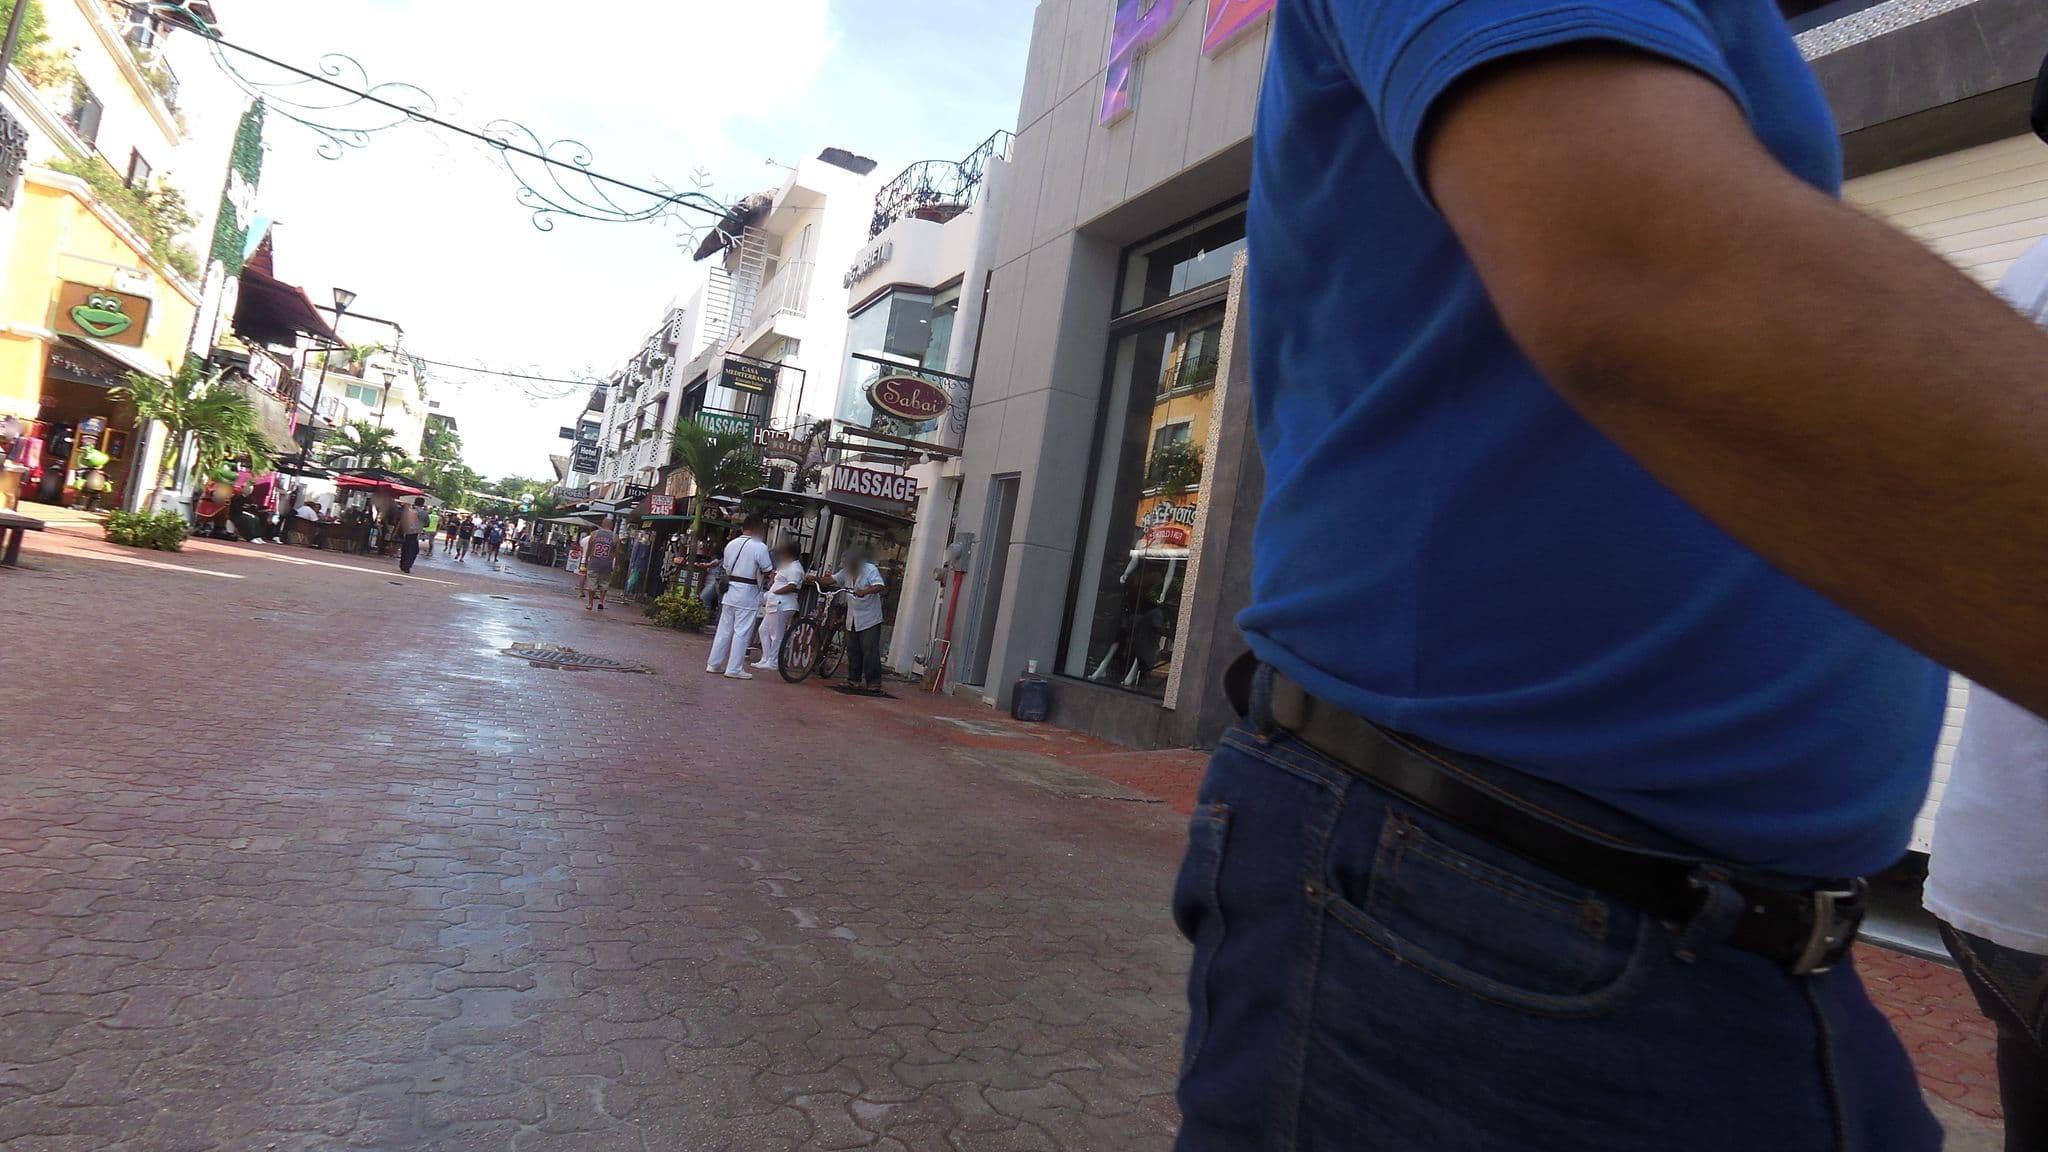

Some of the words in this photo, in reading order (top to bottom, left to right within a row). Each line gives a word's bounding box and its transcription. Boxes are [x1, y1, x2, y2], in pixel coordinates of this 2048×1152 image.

[741, 366, 759, 375] CASA
[883, 381, 938, 413] Sabai
[700, 415, 750, 438] MASSAGE
[580, 446, 597, 457] Hotel
[833, 467, 917, 501] MASSAGE
[594, 543, 610, 557] 23
